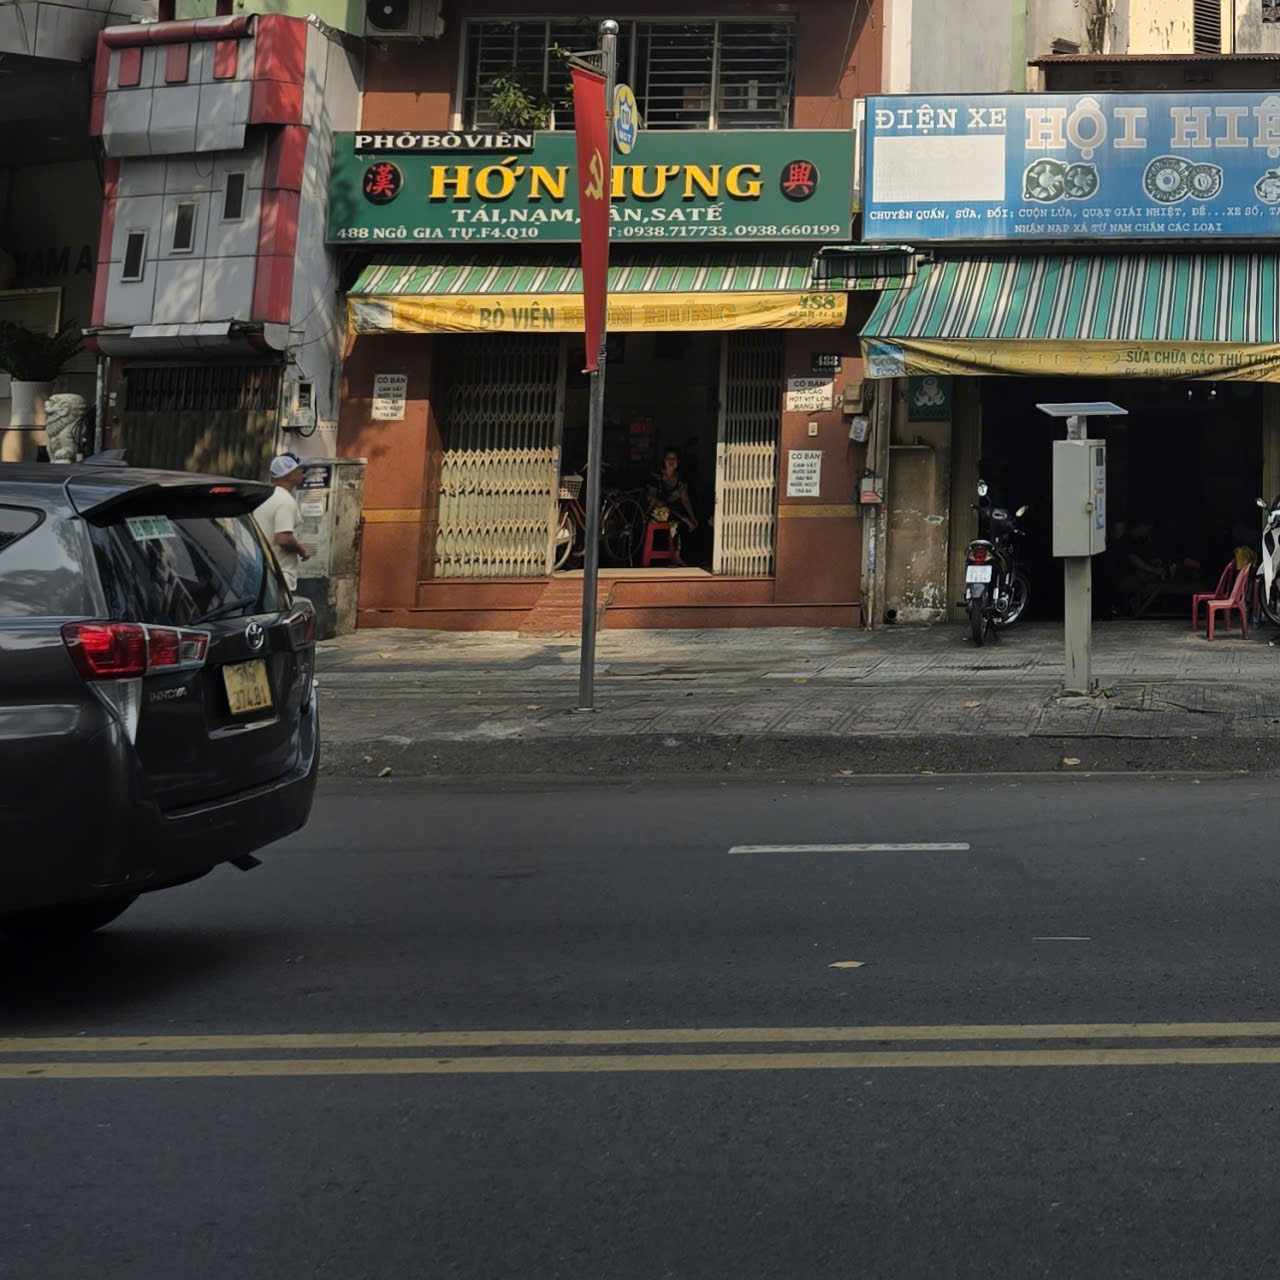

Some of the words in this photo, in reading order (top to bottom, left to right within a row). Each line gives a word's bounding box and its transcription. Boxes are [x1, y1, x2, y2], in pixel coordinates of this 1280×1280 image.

[874, 103, 958, 134] ĐIỆN
[967, 107, 1008, 128] XE
[1025, 96, 1147, 160] HỘI
[355, 131, 419, 149] PHỞ
[464, 131, 532, 149] VIÊN
[365, 162, 396, 196] 漢
[428, 156, 569, 199] HỚN
[783, 162, 815, 196] 興
[869, 209, 913, 220] CHUYÊN
[1109, 223, 1132, 232] NAM
[1167, 222, 1190, 232] CÁC
[337, 227, 369, 239] 488
[373, 225, 407, 239] NGÔ
[413, 227, 443, 239] GIA
[479, 300, 505, 329] BÒ
[512, 300, 555, 329] VIÊN
[799, 294, 836, 310] 488
[1126, 346, 1151, 364] SỬA
[1154, 349, 1187, 365] CHỮA
[1190, 349, 1215, 365] CÁC
[1218, 351, 1244, 366] THỨ
